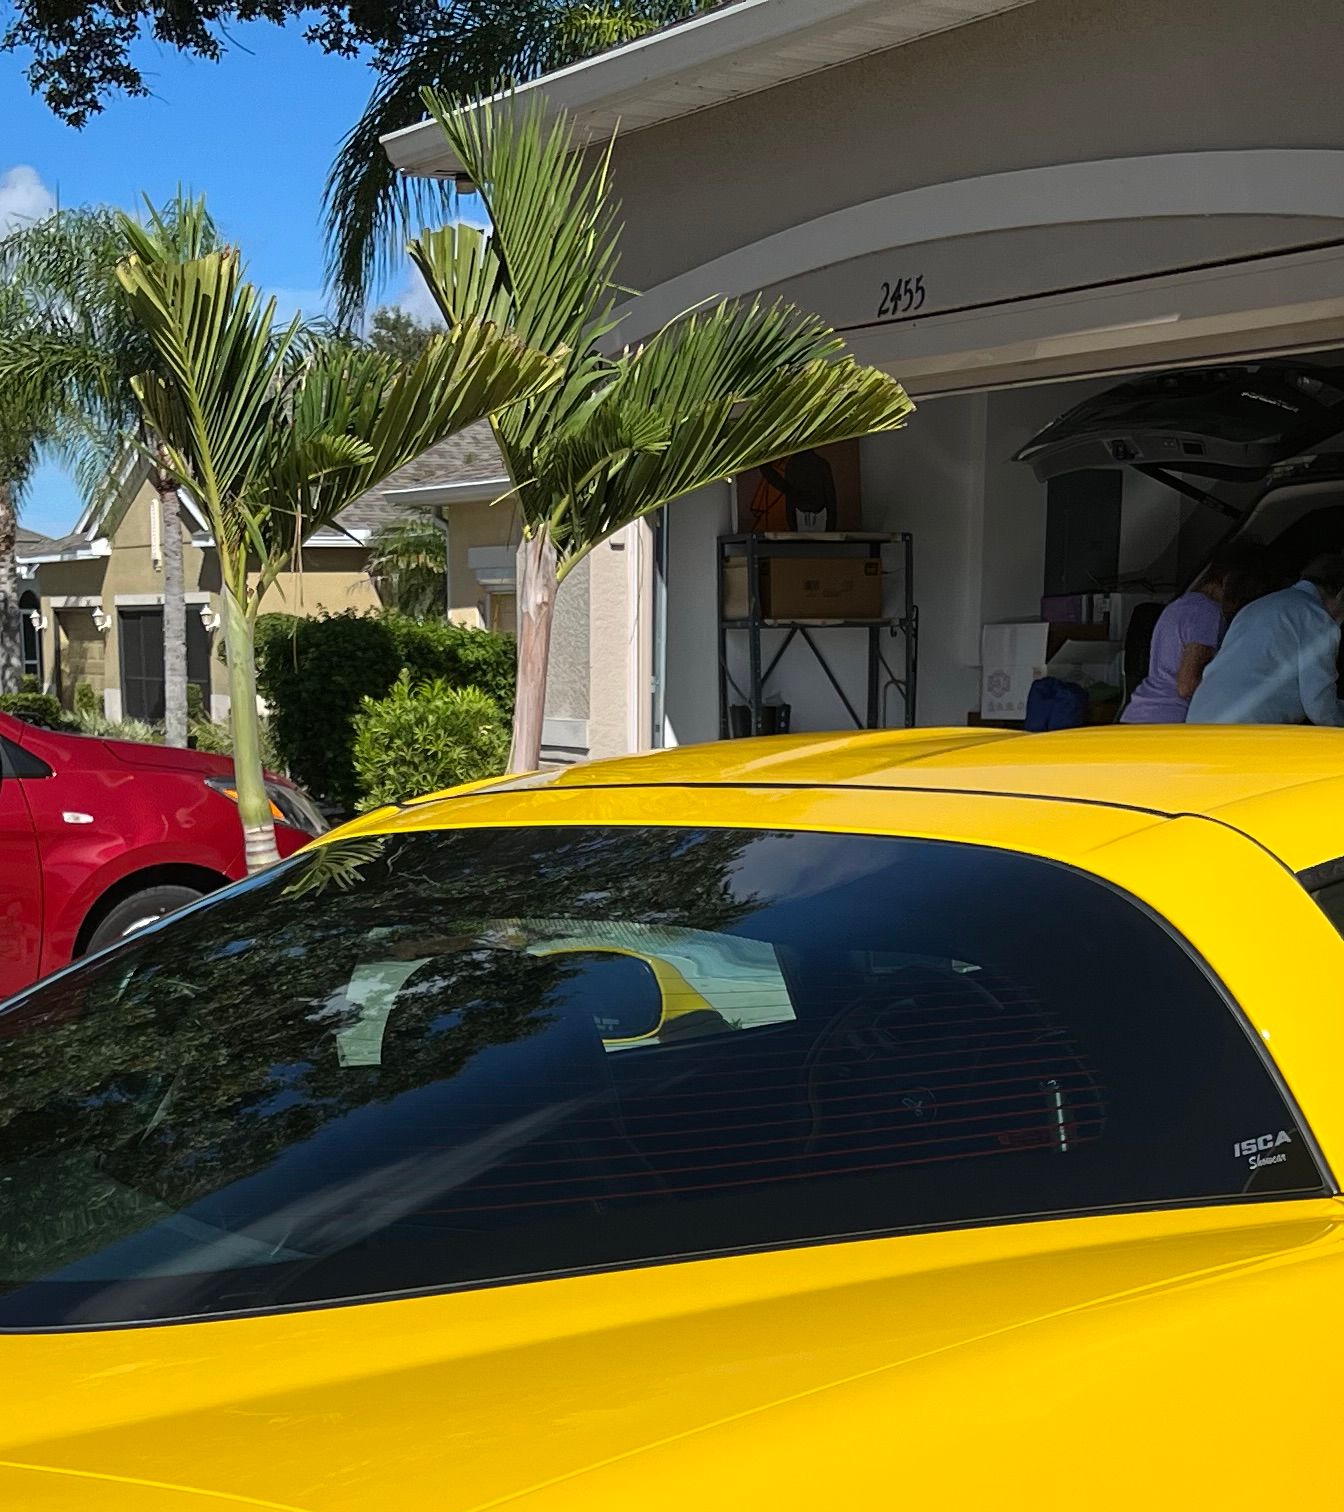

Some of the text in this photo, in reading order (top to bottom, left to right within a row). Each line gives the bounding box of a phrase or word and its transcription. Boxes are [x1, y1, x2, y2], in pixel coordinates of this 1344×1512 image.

[877, 274, 926, 318] 2455
[1232, 1130, 1292, 1158] ISCA
[1248, 1153, 1287, 1170] Showcar
